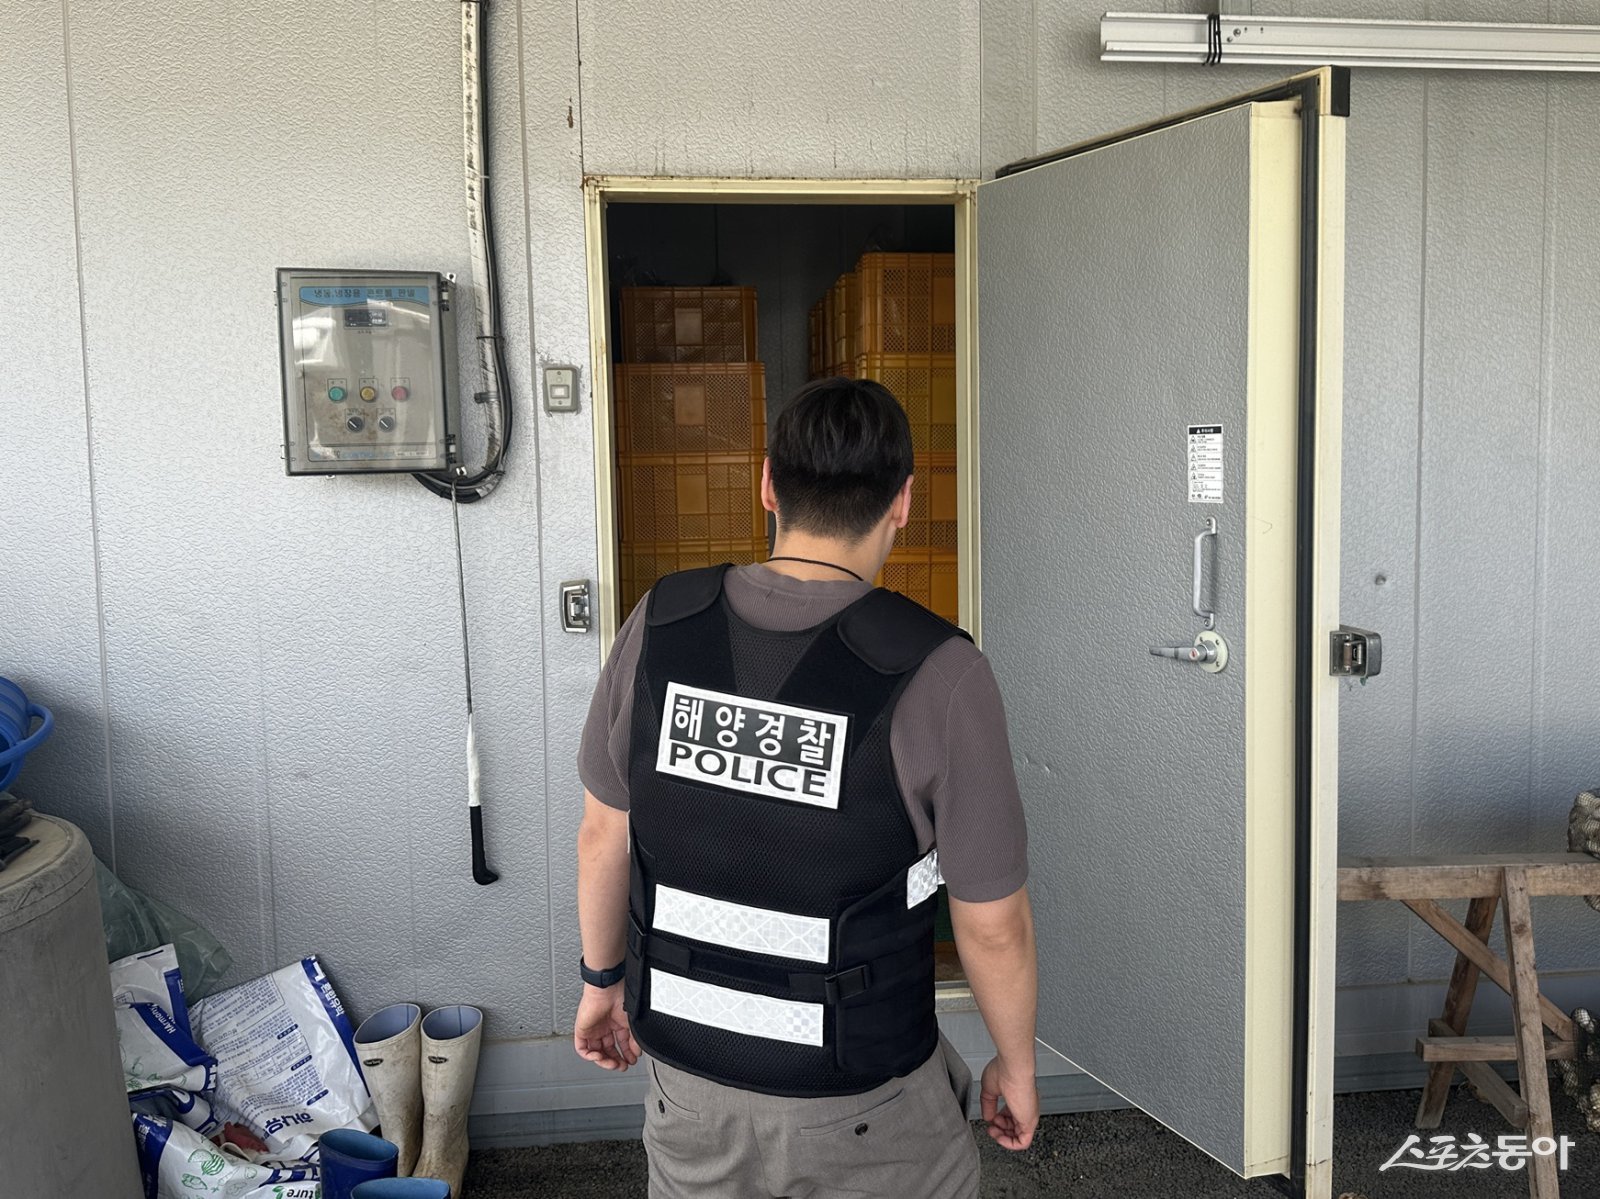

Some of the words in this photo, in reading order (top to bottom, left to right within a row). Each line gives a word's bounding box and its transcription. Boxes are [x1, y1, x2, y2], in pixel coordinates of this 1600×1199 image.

[675, 697, 832, 766] 해양경찰
[669, 742, 827, 798] POLICE
[286, 1189, 320, 1199] ture
